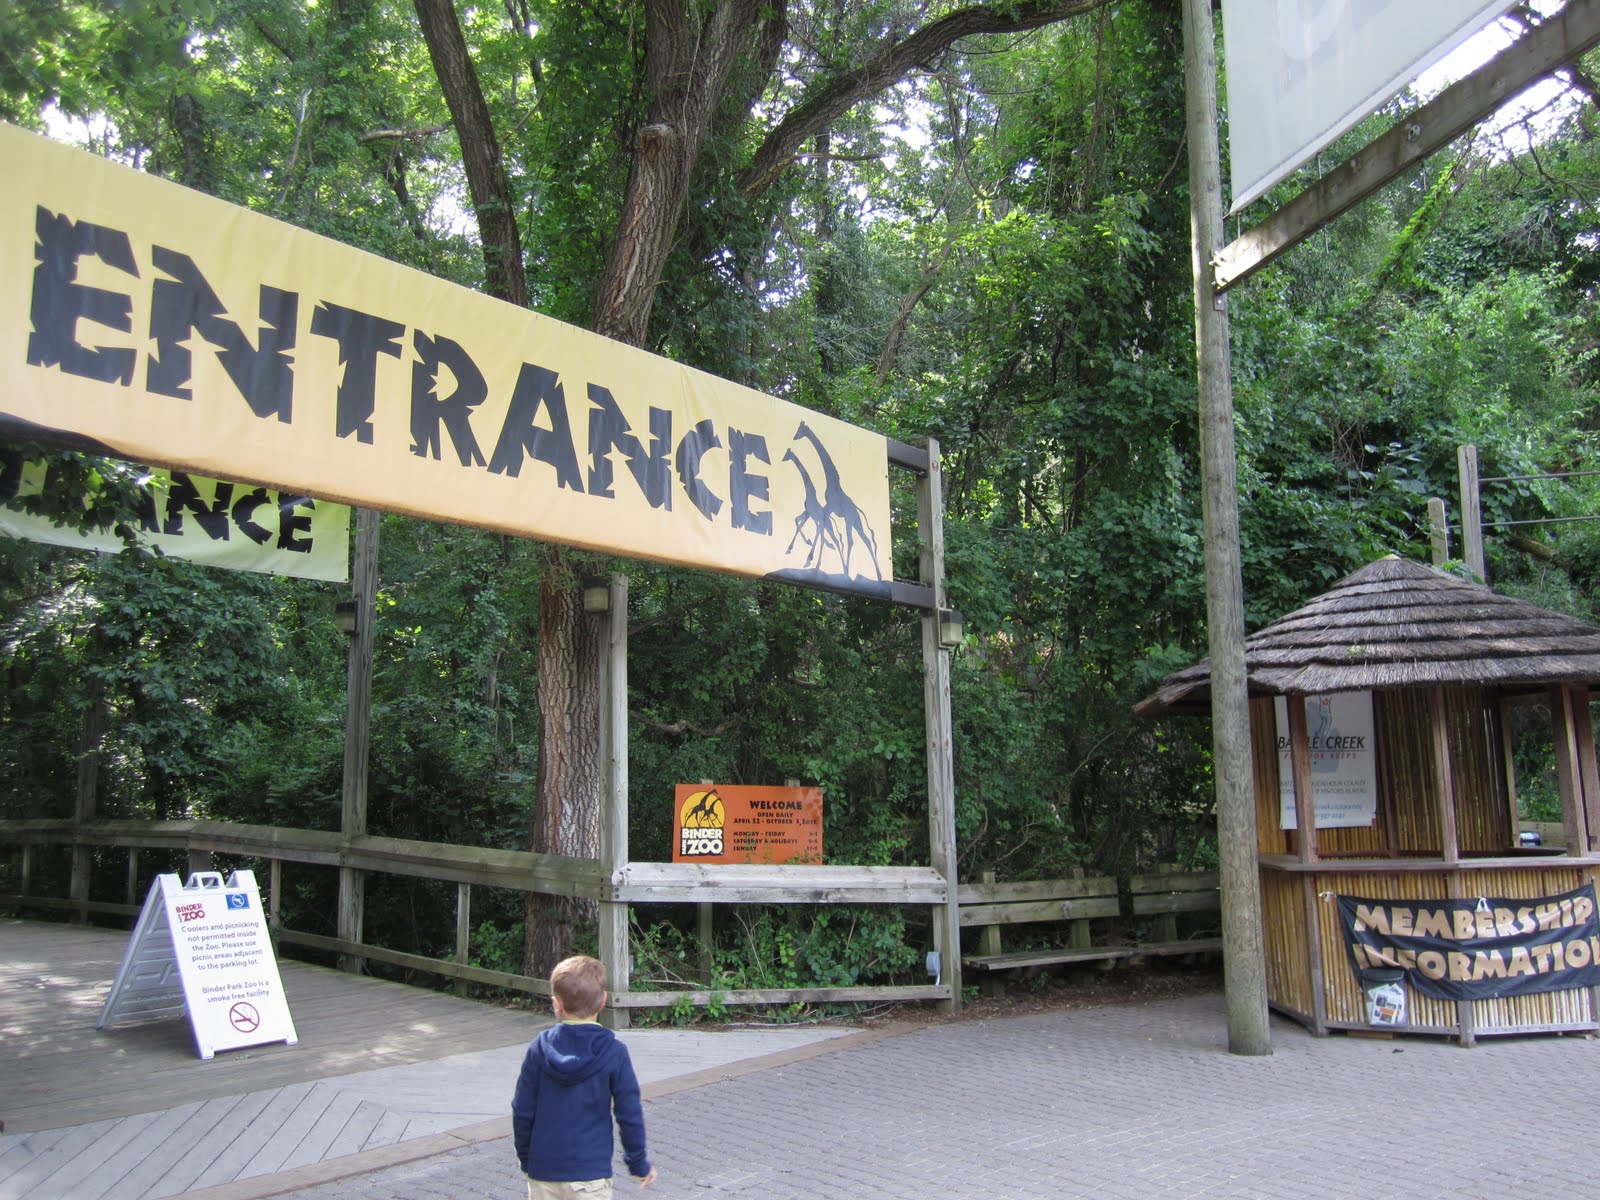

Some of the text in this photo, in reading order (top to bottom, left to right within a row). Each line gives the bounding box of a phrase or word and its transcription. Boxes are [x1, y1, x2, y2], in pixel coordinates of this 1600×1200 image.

[25, 205, 774, 536] ENTRANCE
[1278, 736, 1365, 749] BALE CREEK
[750, 800, 803, 810] WELCOME
[681, 828, 723, 839] BINDER
[687, 839, 723, 854] ZOO
[175, 903, 203, 914] BINDER
[181, 910, 206, 922] ZOO
[1353, 896, 1593, 940] MEMBERSHIP
[210, 923, 224, 931] and
[225, 921, 259, 930] picnicking
[201, 932, 236, 942] permitted
[236, 930, 257, 938] inside
[221, 941, 244, 949] Please
[191, 954, 213, 962] picnic
[233, 948, 263, 958] adjacent
[207, 961, 219, 969] the
[220, 959, 247, 969] parking
[201, 985, 226, 994] Binder
[226, 982, 243, 991] Park
[243, 981, 258, 989] Zoo
[207, 988, 270, 1003] smoke free facility
